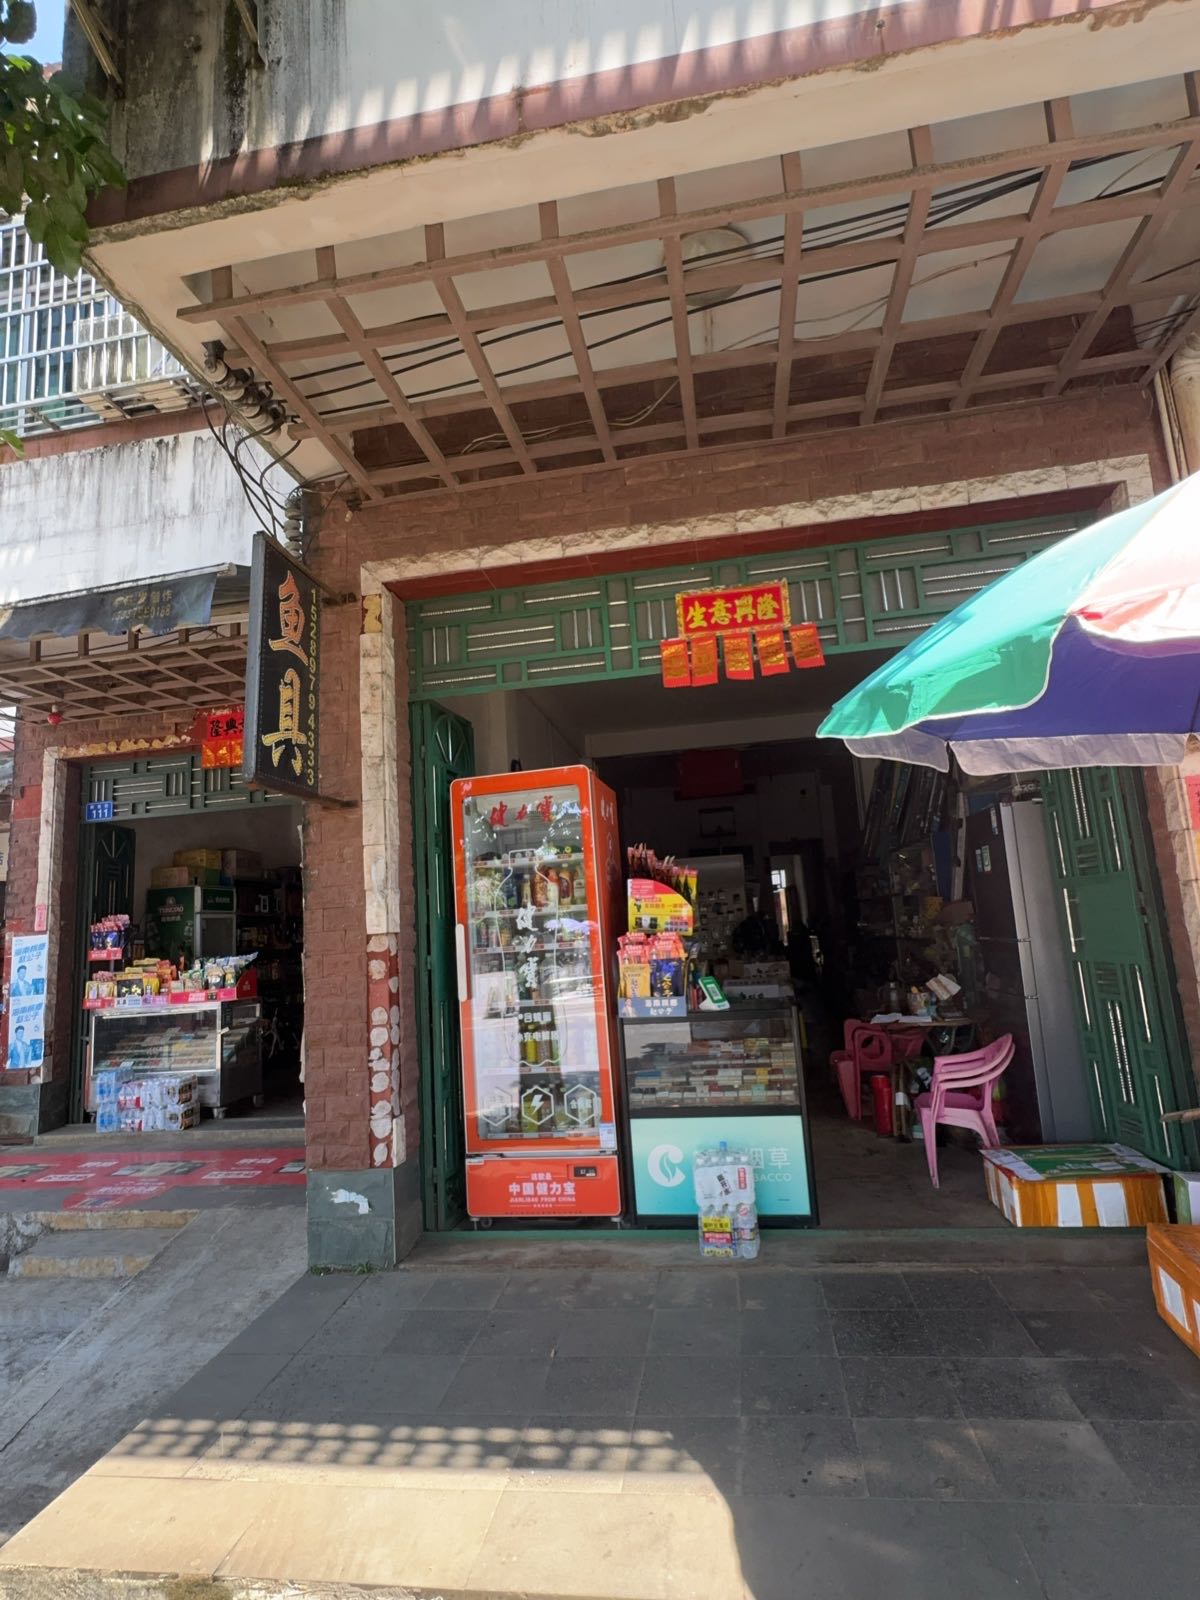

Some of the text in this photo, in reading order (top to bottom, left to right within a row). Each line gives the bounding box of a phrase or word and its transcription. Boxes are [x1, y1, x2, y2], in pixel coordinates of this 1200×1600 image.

[685, 593, 780, 629] 生意興隆
[92, 808, 108, 819] 111
[508, 1182, 576, 1196] 中国健力宝
